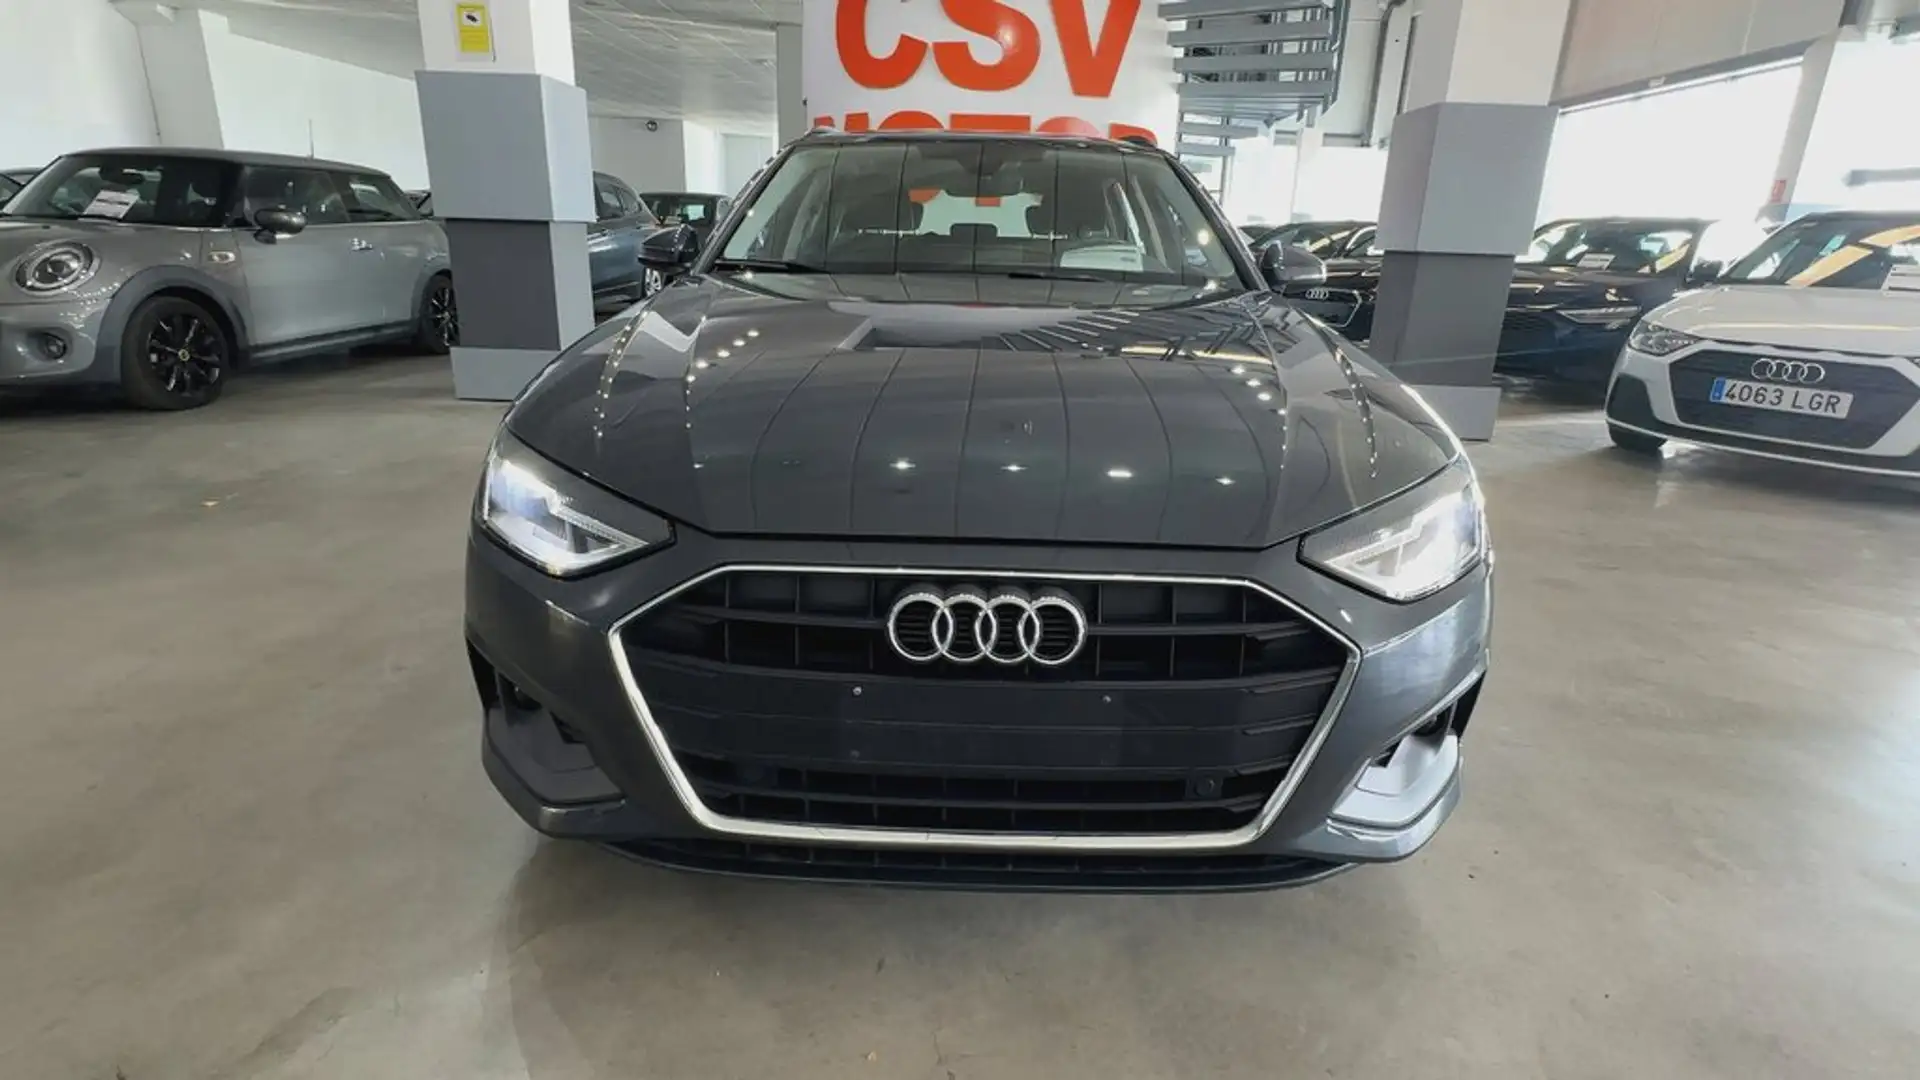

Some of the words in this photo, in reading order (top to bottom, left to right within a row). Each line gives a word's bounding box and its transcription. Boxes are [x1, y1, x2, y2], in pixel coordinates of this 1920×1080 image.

[836, 0, 1141, 98] CSV
[1725, 383, 1784, 406] 4063
[1791, 389, 1841, 414] LGR
